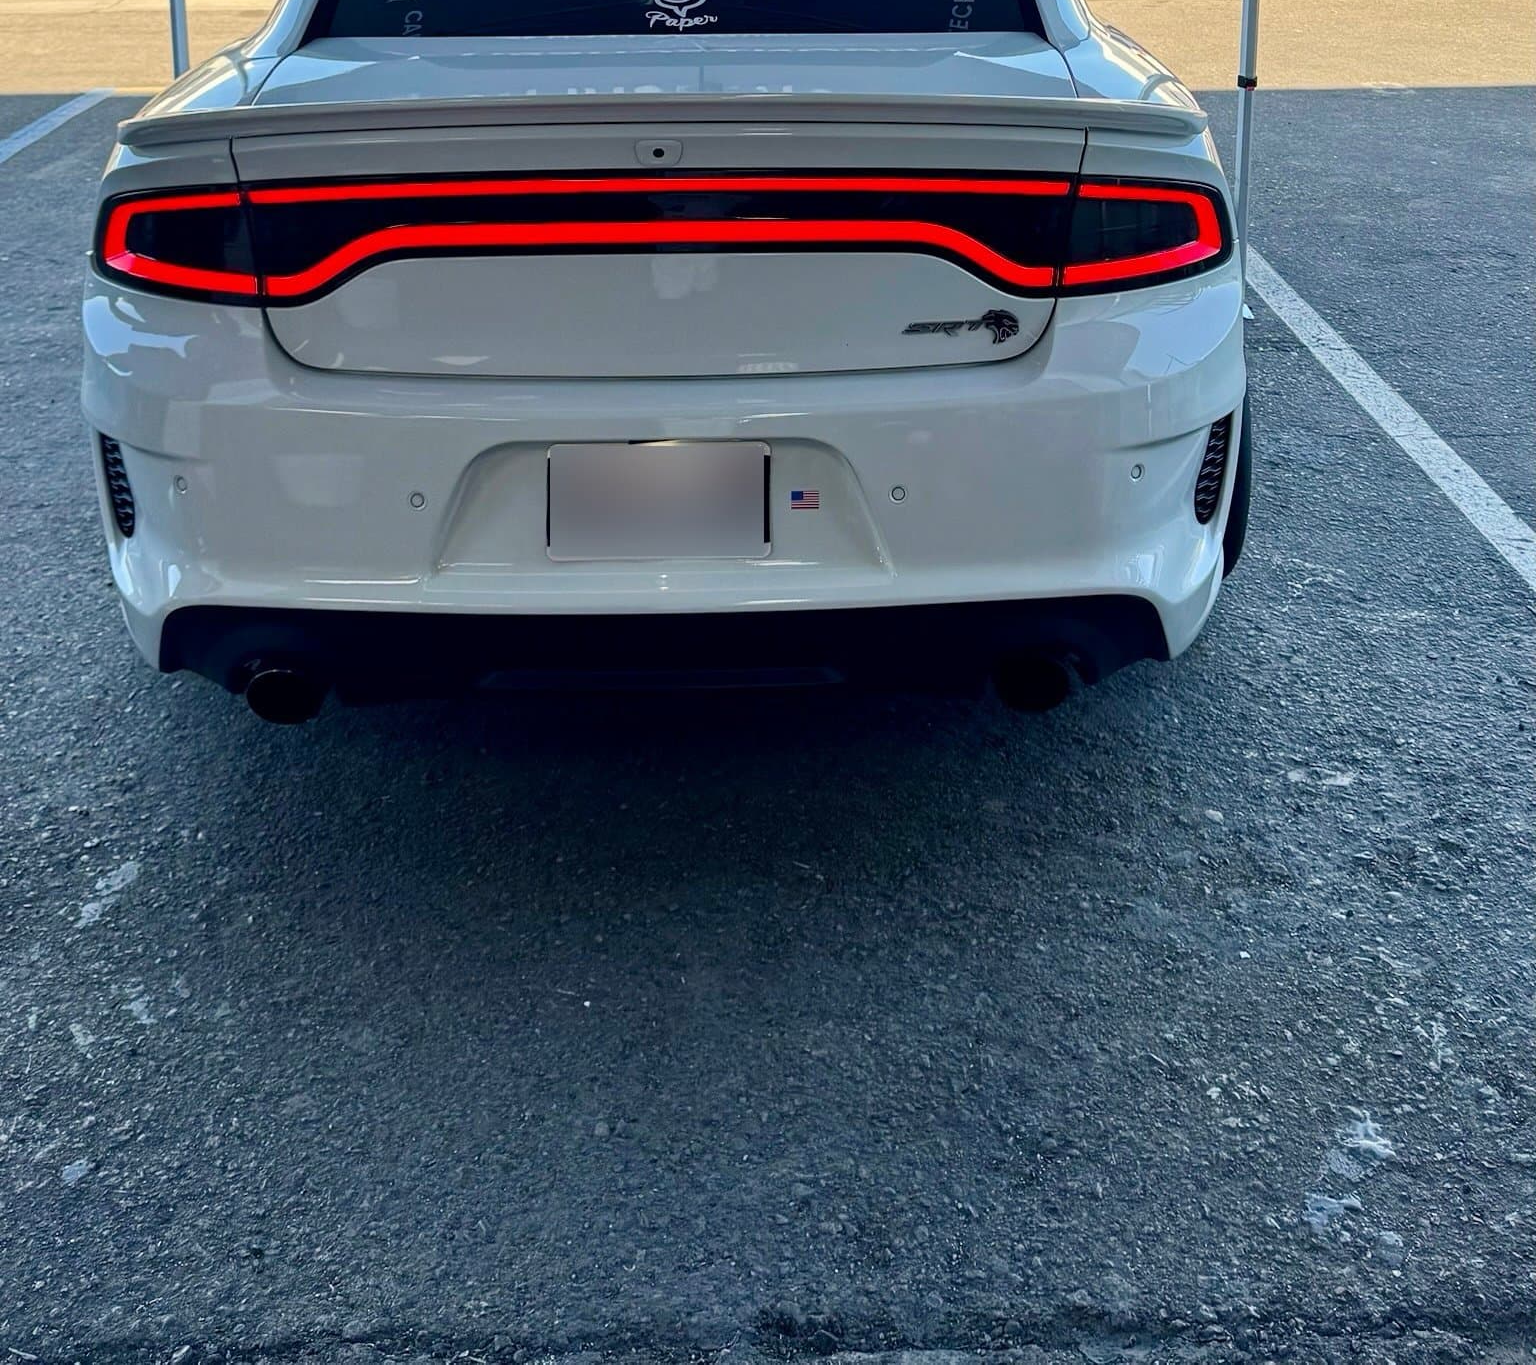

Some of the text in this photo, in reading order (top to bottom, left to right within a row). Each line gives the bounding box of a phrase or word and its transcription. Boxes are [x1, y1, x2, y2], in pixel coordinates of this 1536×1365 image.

[402, 10, 423, 37] CA
[645, 11, 718, 32] Paper
[901, 320, 983, 337] SRT
